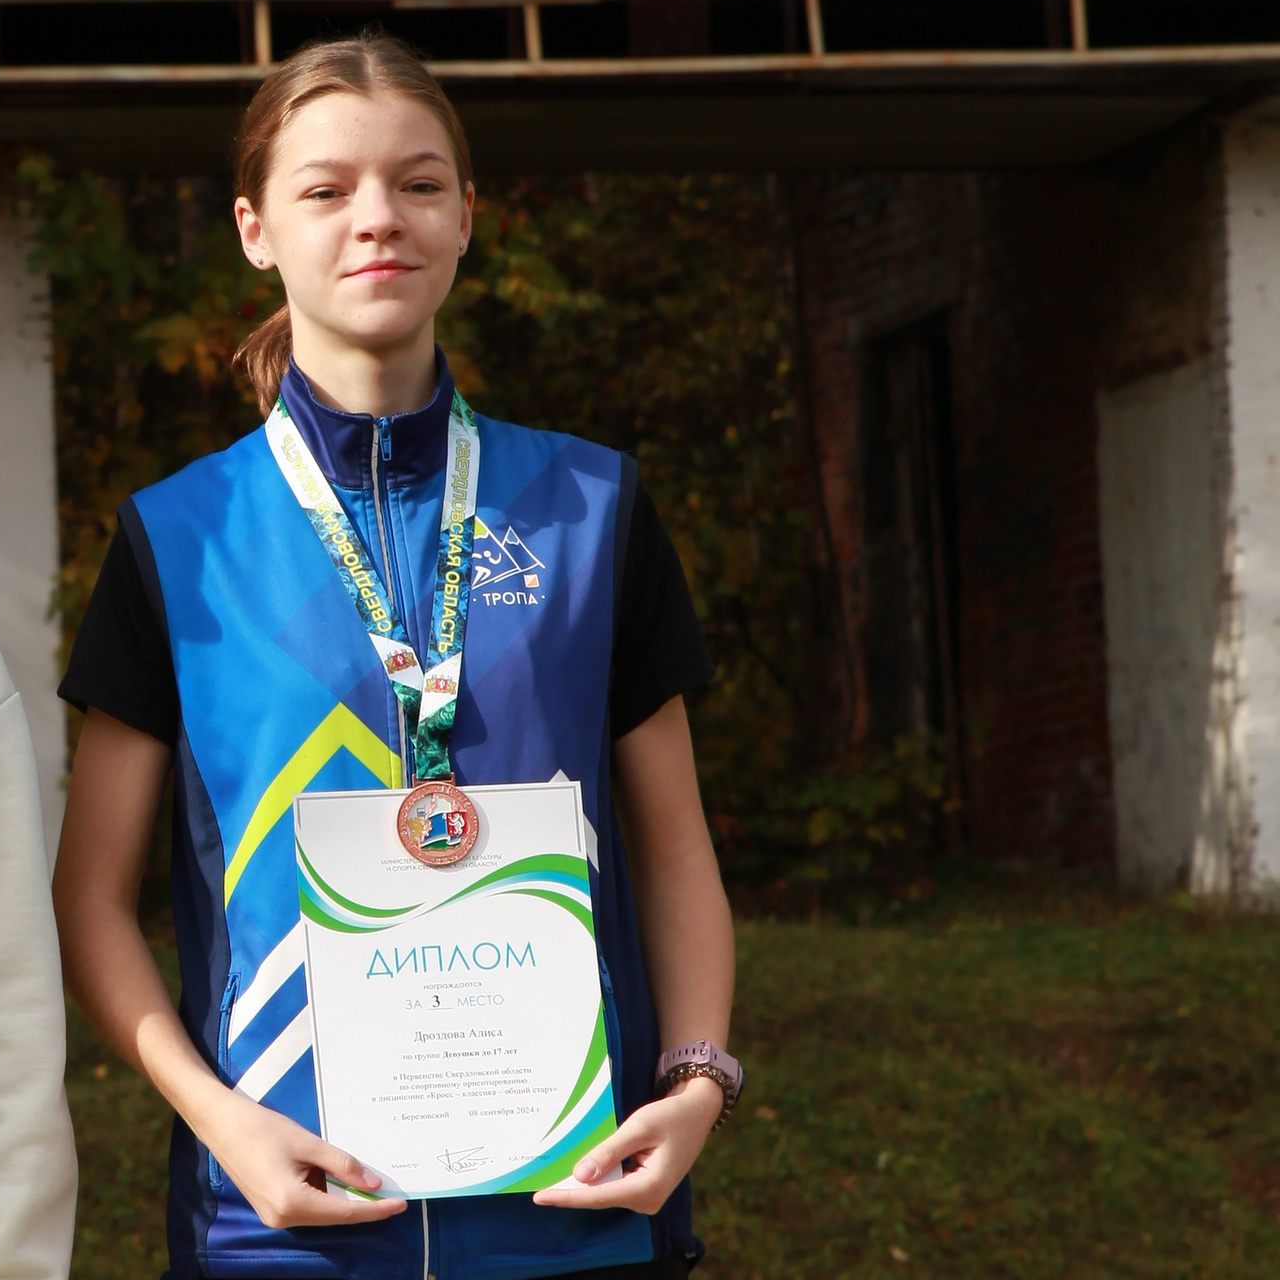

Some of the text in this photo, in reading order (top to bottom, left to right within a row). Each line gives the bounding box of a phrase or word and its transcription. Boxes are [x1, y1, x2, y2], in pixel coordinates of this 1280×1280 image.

[282, 434, 393, 633] СВЕРДЛОВСКАЯ ОБЛАСТЬ
[438, 437, 470, 653] СВЕРДЛОВСКАЯ ОБЛАСТЬ
[482, 591, 539, 607] ТРОПА
[366, 941, 537, 980] ДИПЛОМ
[423, 981, 483, 991] награждается
[405, 994, 504, 1011] ЗА 3 МЕСТО
[413, 1028, 503, 1043] Дроздова Алиса
[403, 1053, 413, 1061] по
[442, 1050, 480, 1061] Девушки
[481, 1050, 492, 1058] до
[492, 1048, 503, 1056] 17
[503, 1048, 518, 1056] лет
[445, 1068, 500, 1080] Свердловской
[501, 1066, 532, 1076] области
[410, 1081, 461, 1092] спортивному
[401, 1111, 450, 1122] Березовский
[468, 1109, 478, 1117] 08
[480, 1107, 515, 1118] сентября
[516, 1106, 535, 1115] 2024
